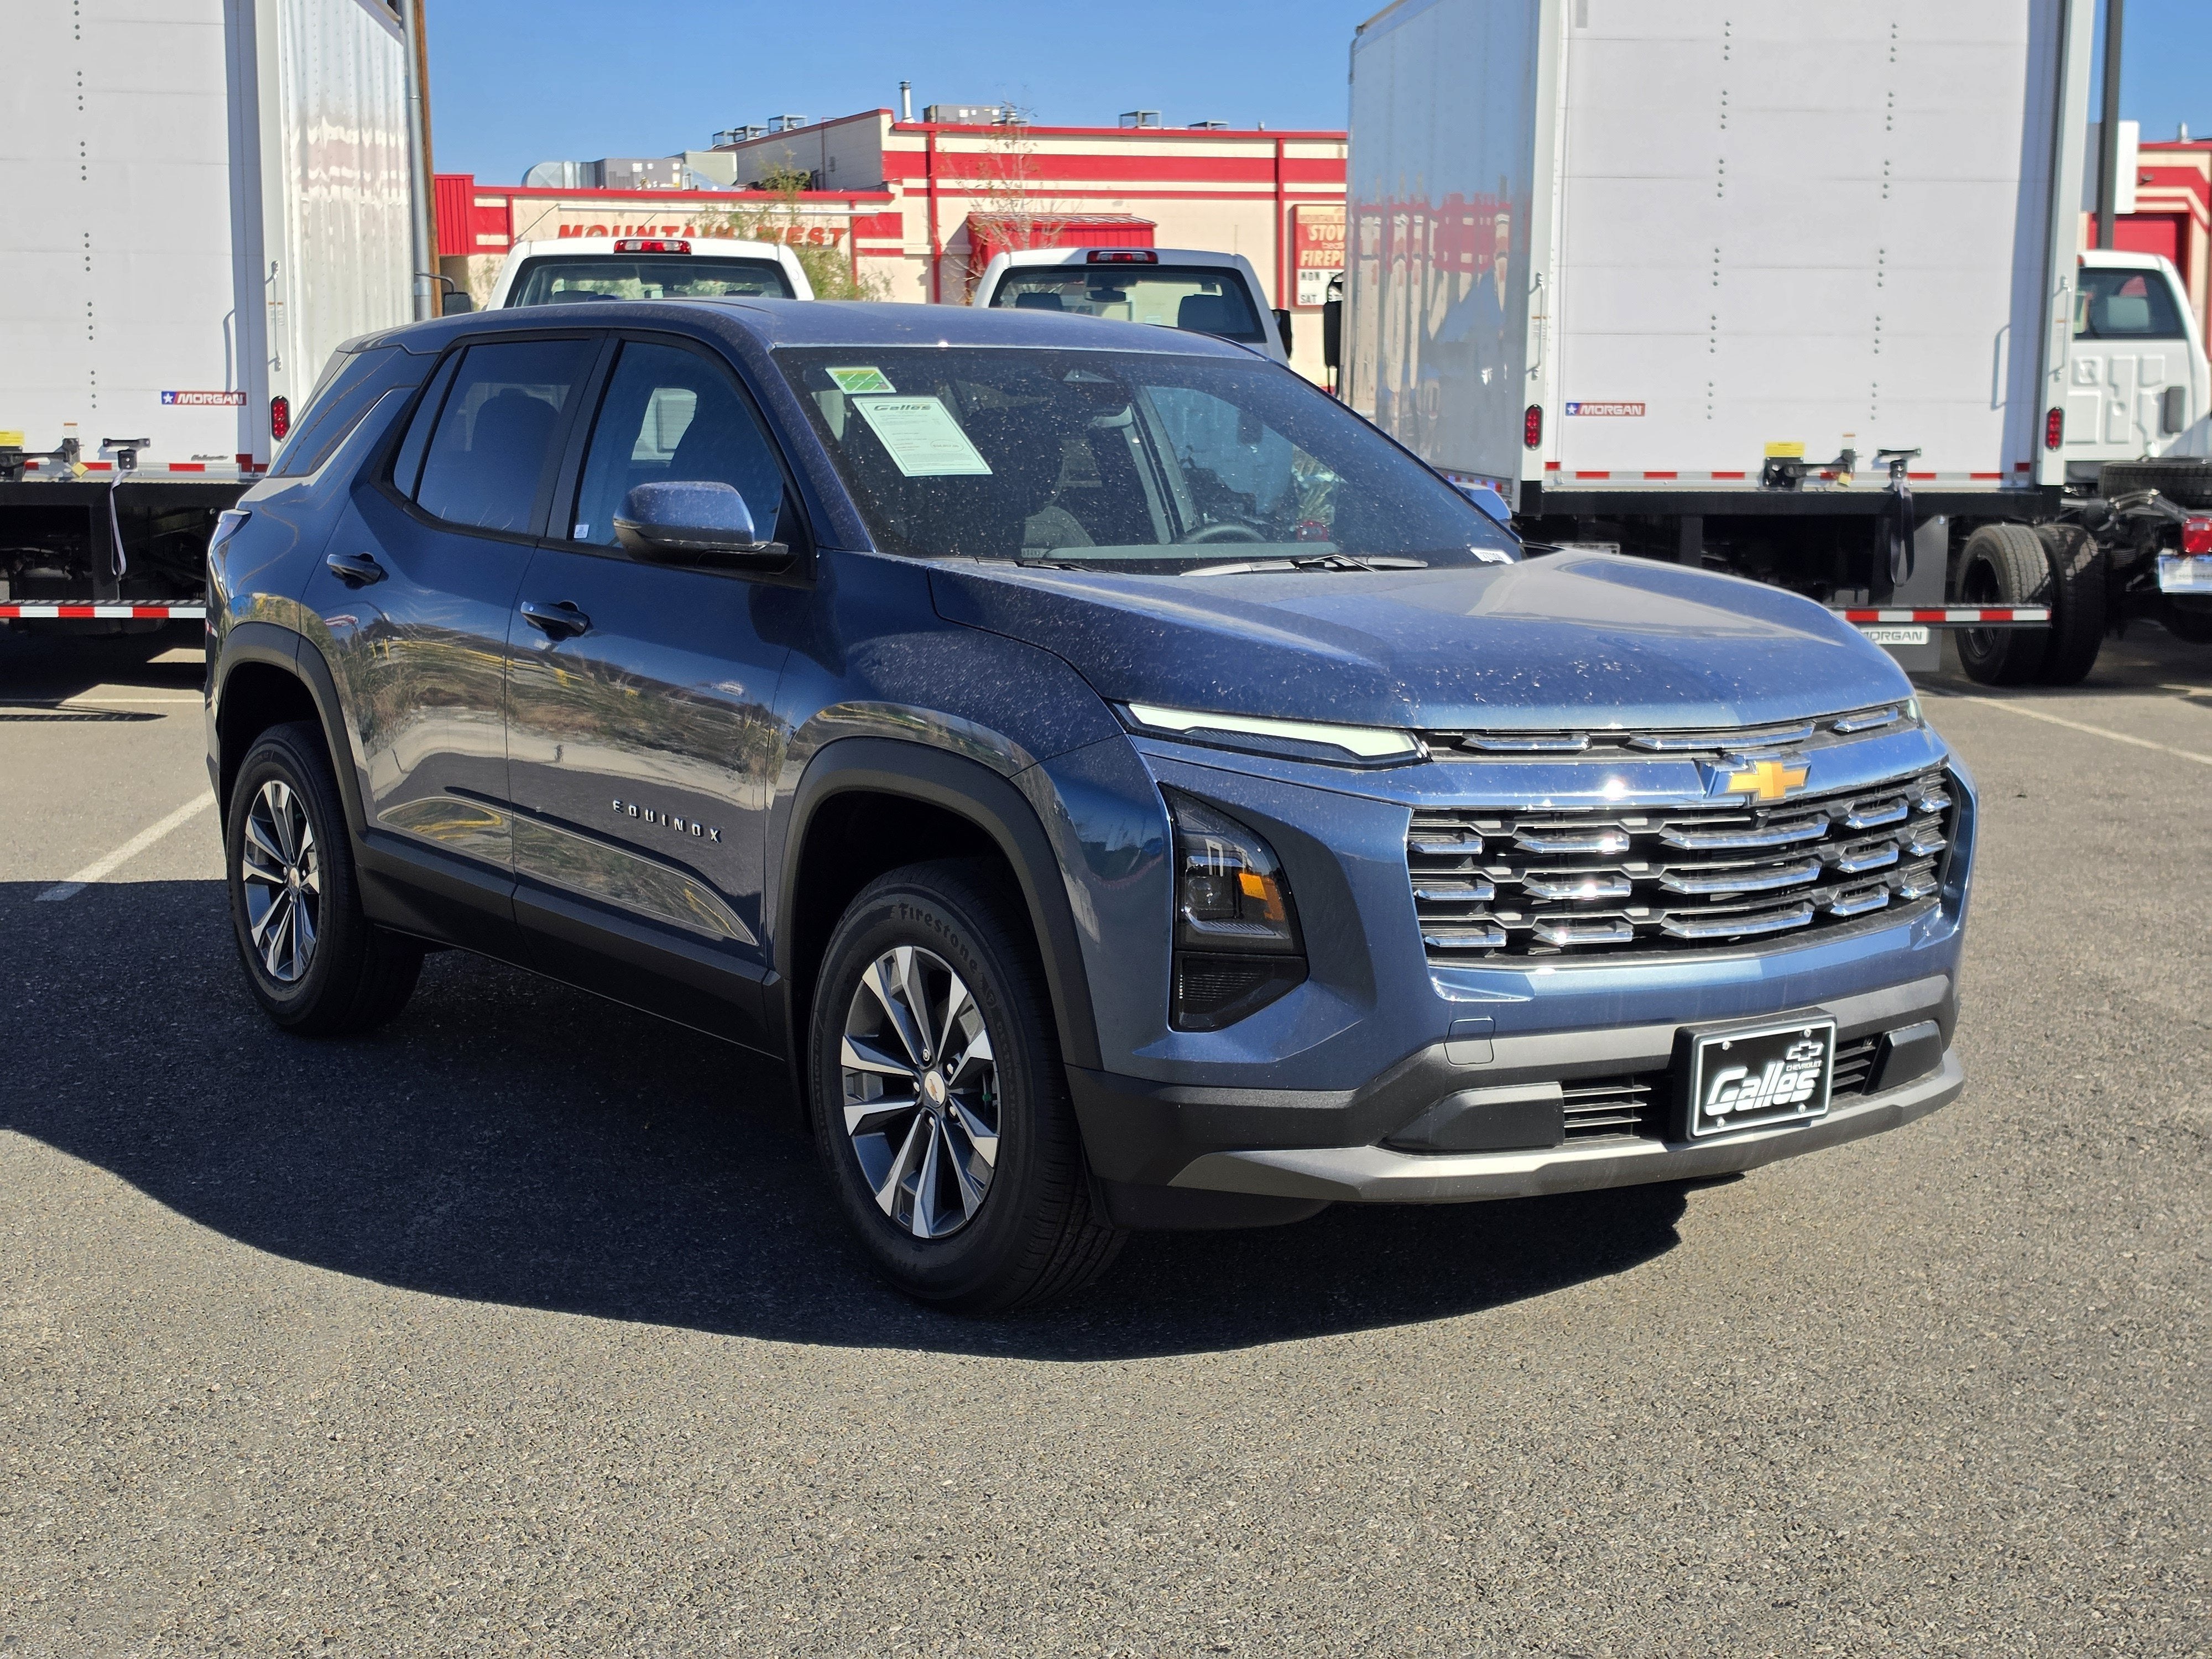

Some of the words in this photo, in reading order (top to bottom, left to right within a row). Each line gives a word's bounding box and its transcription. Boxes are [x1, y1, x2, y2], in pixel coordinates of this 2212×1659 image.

[1301, 295, 1317, 304] SAT
[177, 393, 243, 405] MORGAN
[1579, 404, 1642, 415] MORGAN
[613, 800, 719, 843] EQUINOX
[899, 902, 978, 974] Firestone
[1786, 1060, 1823, 1072] CHEVROLET
[1704, 1060, 1820, 1116] Galles
